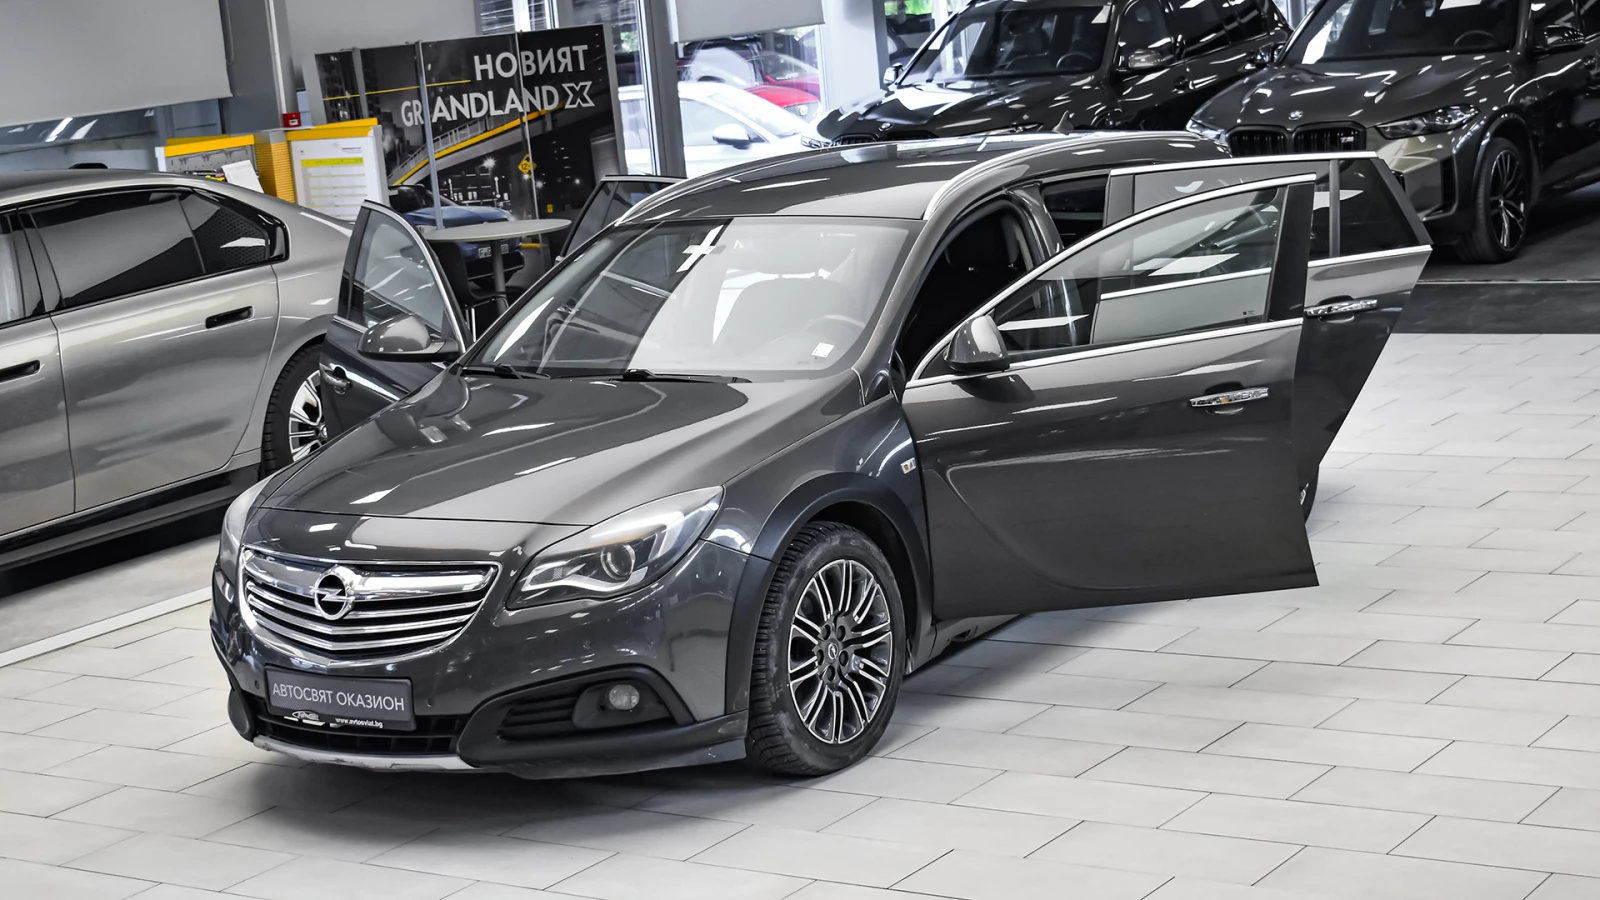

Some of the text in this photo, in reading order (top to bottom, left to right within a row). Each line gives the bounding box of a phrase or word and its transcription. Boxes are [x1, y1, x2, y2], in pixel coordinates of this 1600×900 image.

[473, 45, 588, 81] НОВИЯТ
[400, 81, 595, 127] GRANDLAND X
[272, 682, 405, 711] АВТОСВЯТ ОКАЗИОН
[335, 717, 383, 729] www.avtosviat.bg
